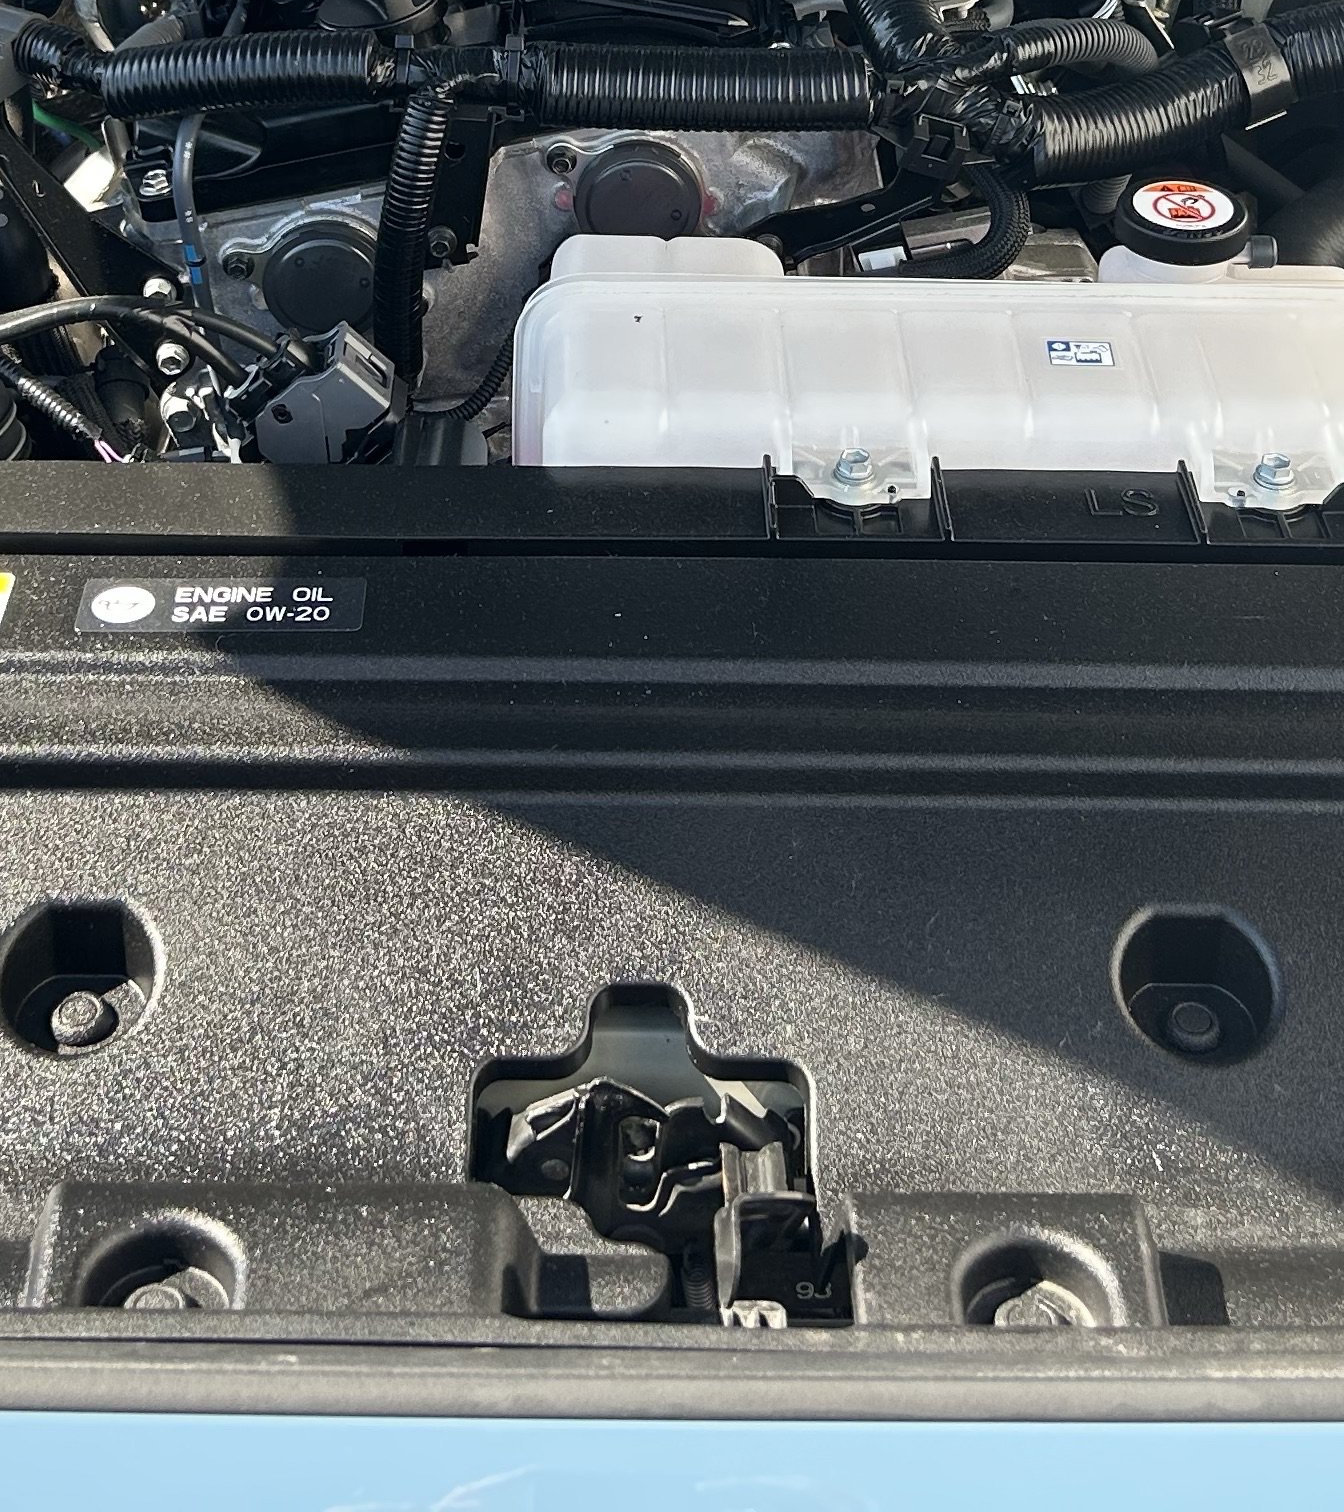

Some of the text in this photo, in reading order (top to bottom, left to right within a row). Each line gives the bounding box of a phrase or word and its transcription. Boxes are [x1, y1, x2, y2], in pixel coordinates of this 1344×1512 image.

[1083, 488, 1160, 517] LS
[173, 586, 334, 603] ENGINE OIL
[171, 605, 331, 622] SAE 0W-20
